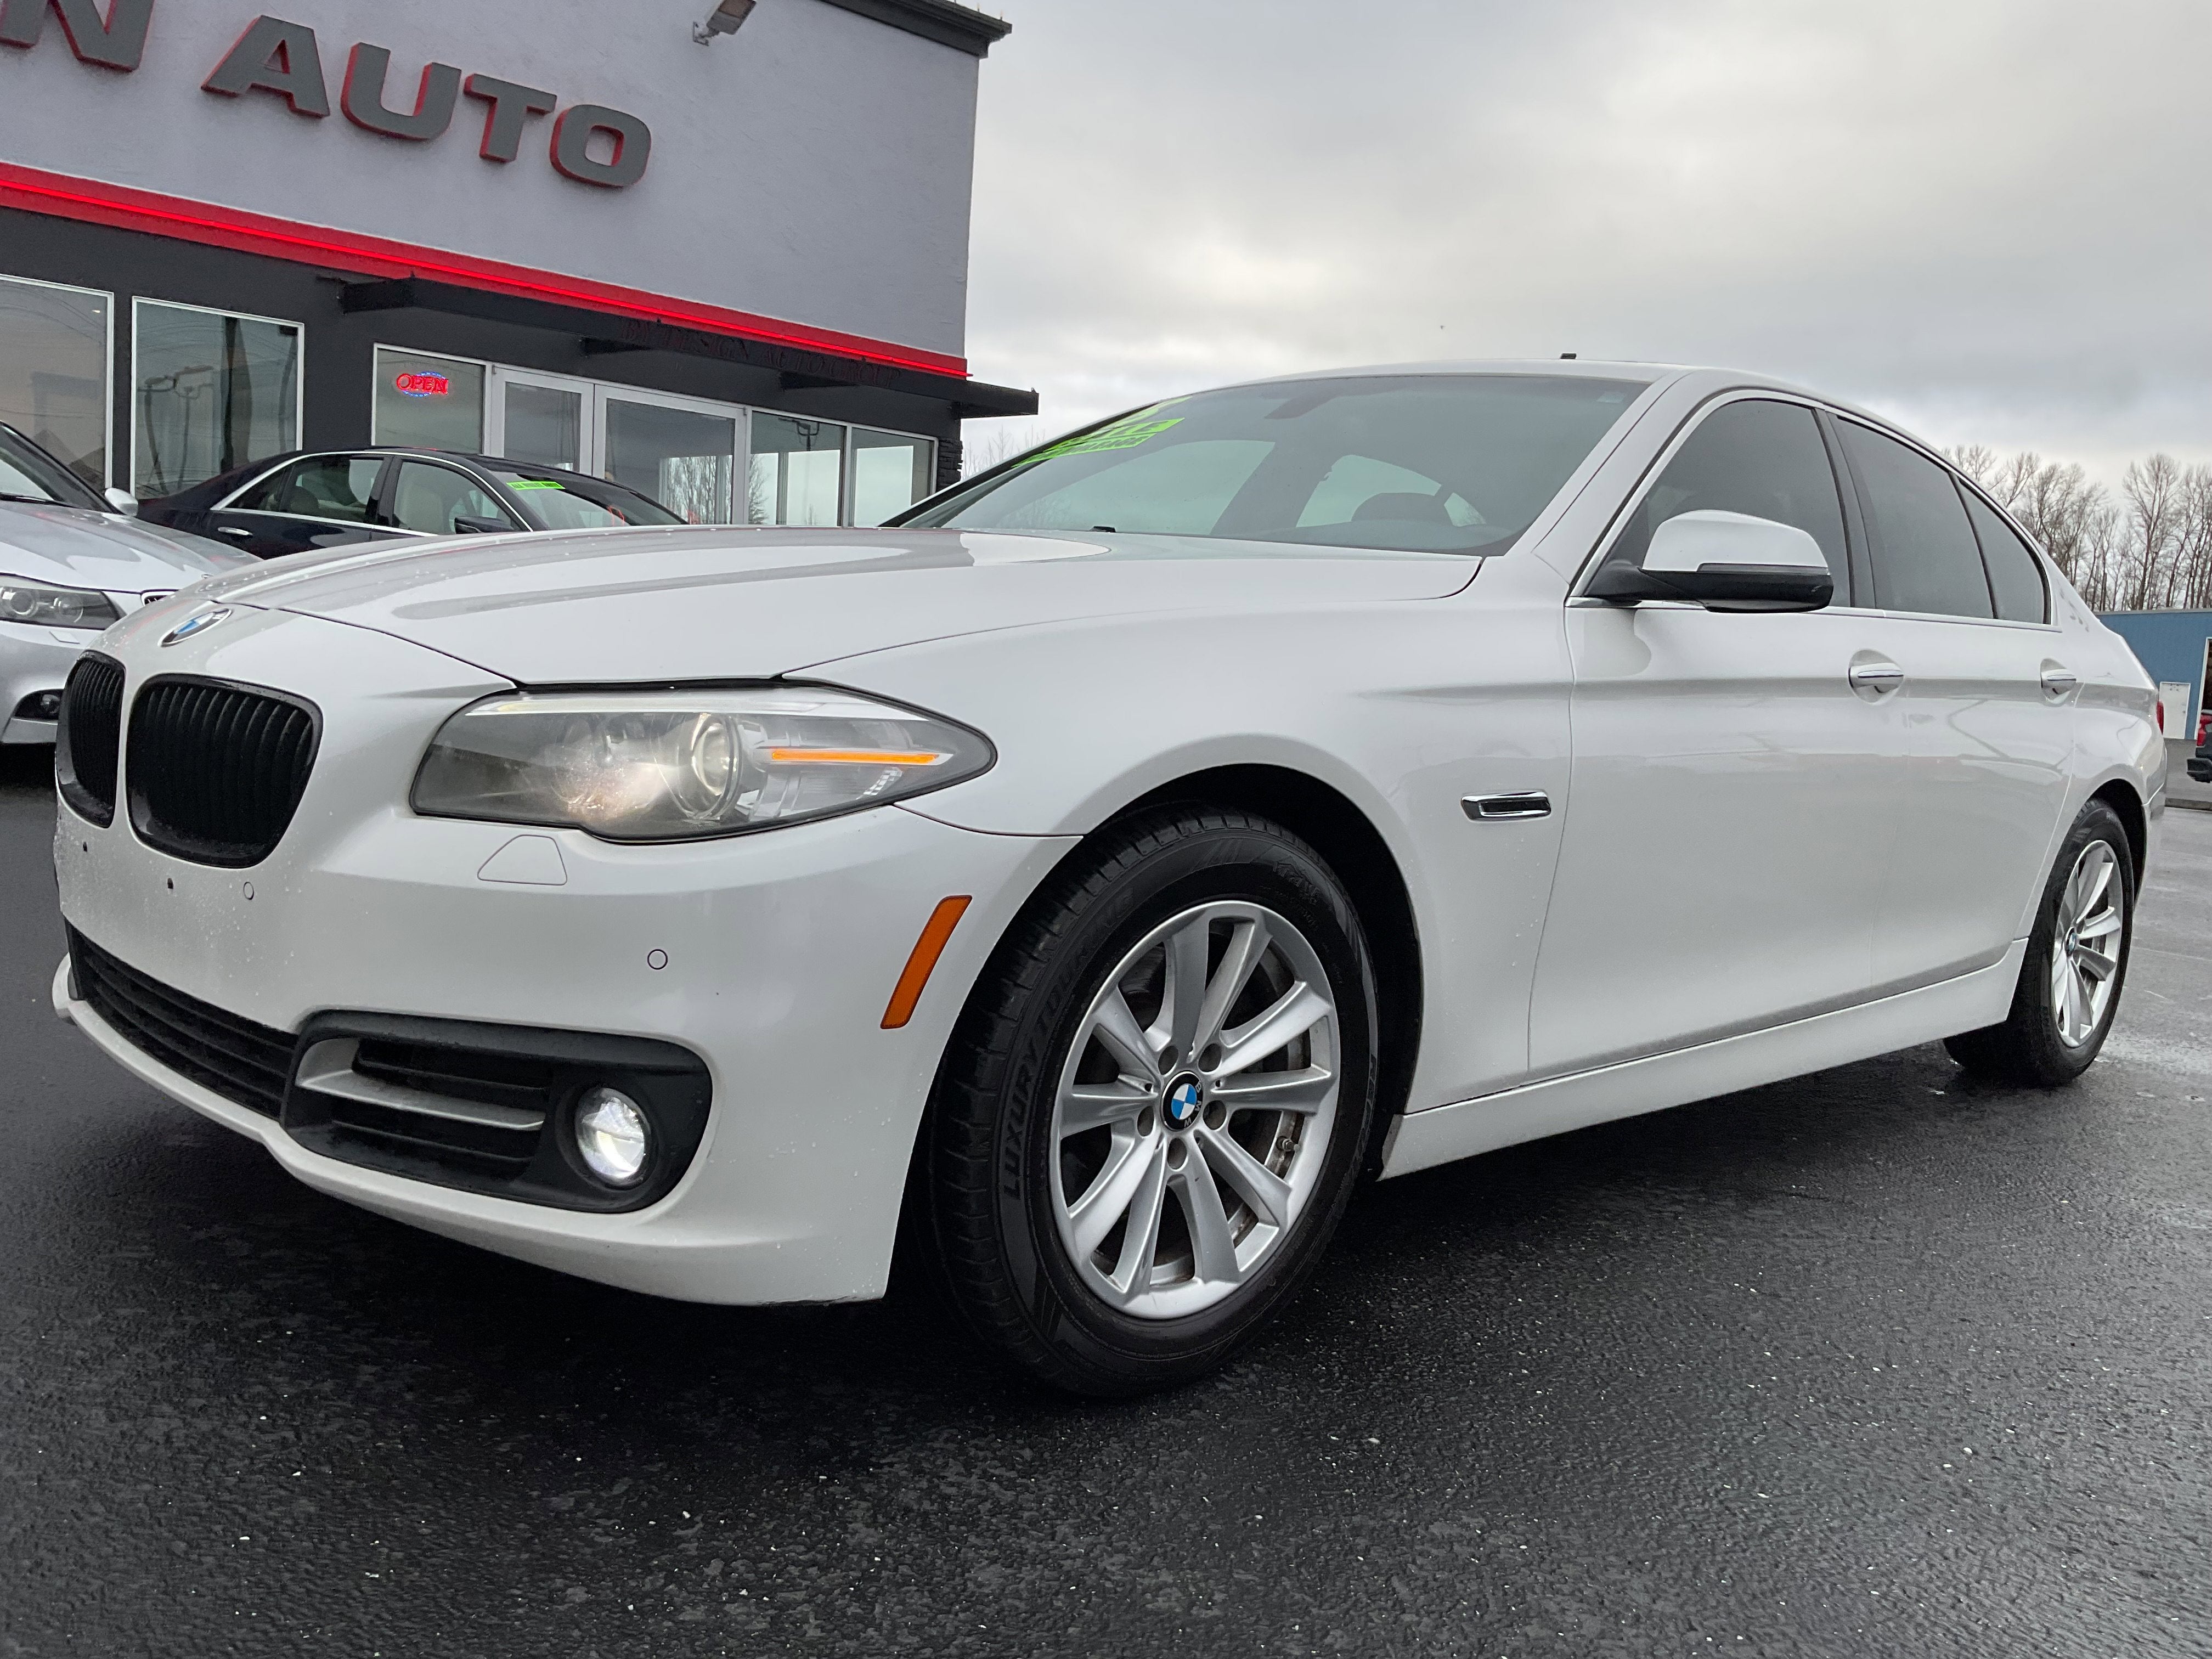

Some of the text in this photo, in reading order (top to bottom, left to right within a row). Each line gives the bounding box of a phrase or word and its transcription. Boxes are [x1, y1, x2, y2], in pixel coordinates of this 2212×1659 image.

[200, 14, 652, 187] AUTO
[396, 373, 449, 395] OPEN
[1003, 1036, 1038, 1200] LUXURY
[1183, 1080, 1203, 1128] BMW
